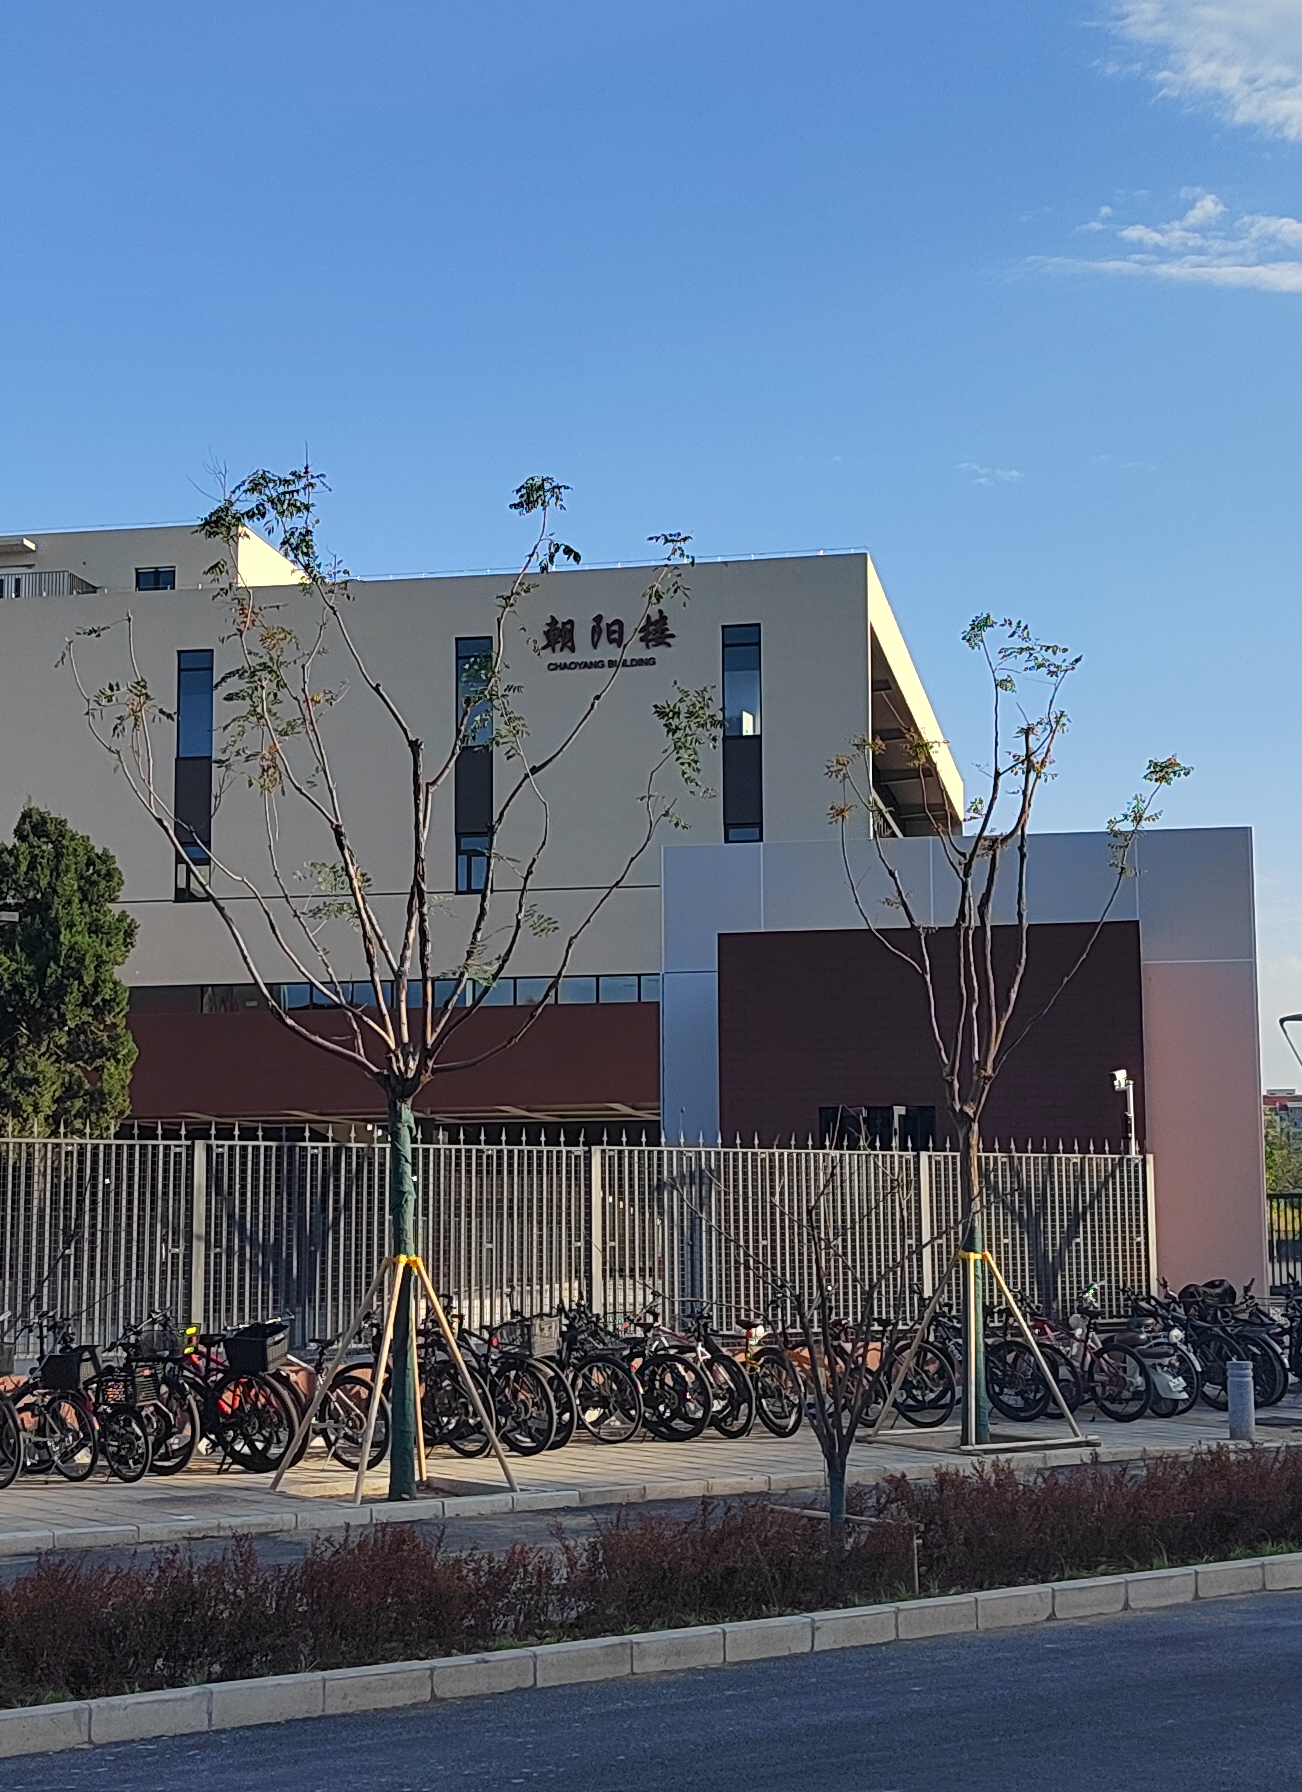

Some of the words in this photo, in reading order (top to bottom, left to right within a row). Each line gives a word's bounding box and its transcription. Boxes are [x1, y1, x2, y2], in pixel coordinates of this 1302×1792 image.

[541, 609, 675, 653] 朝阳楼
[547, 660, 605, 671] CHAOYANG
